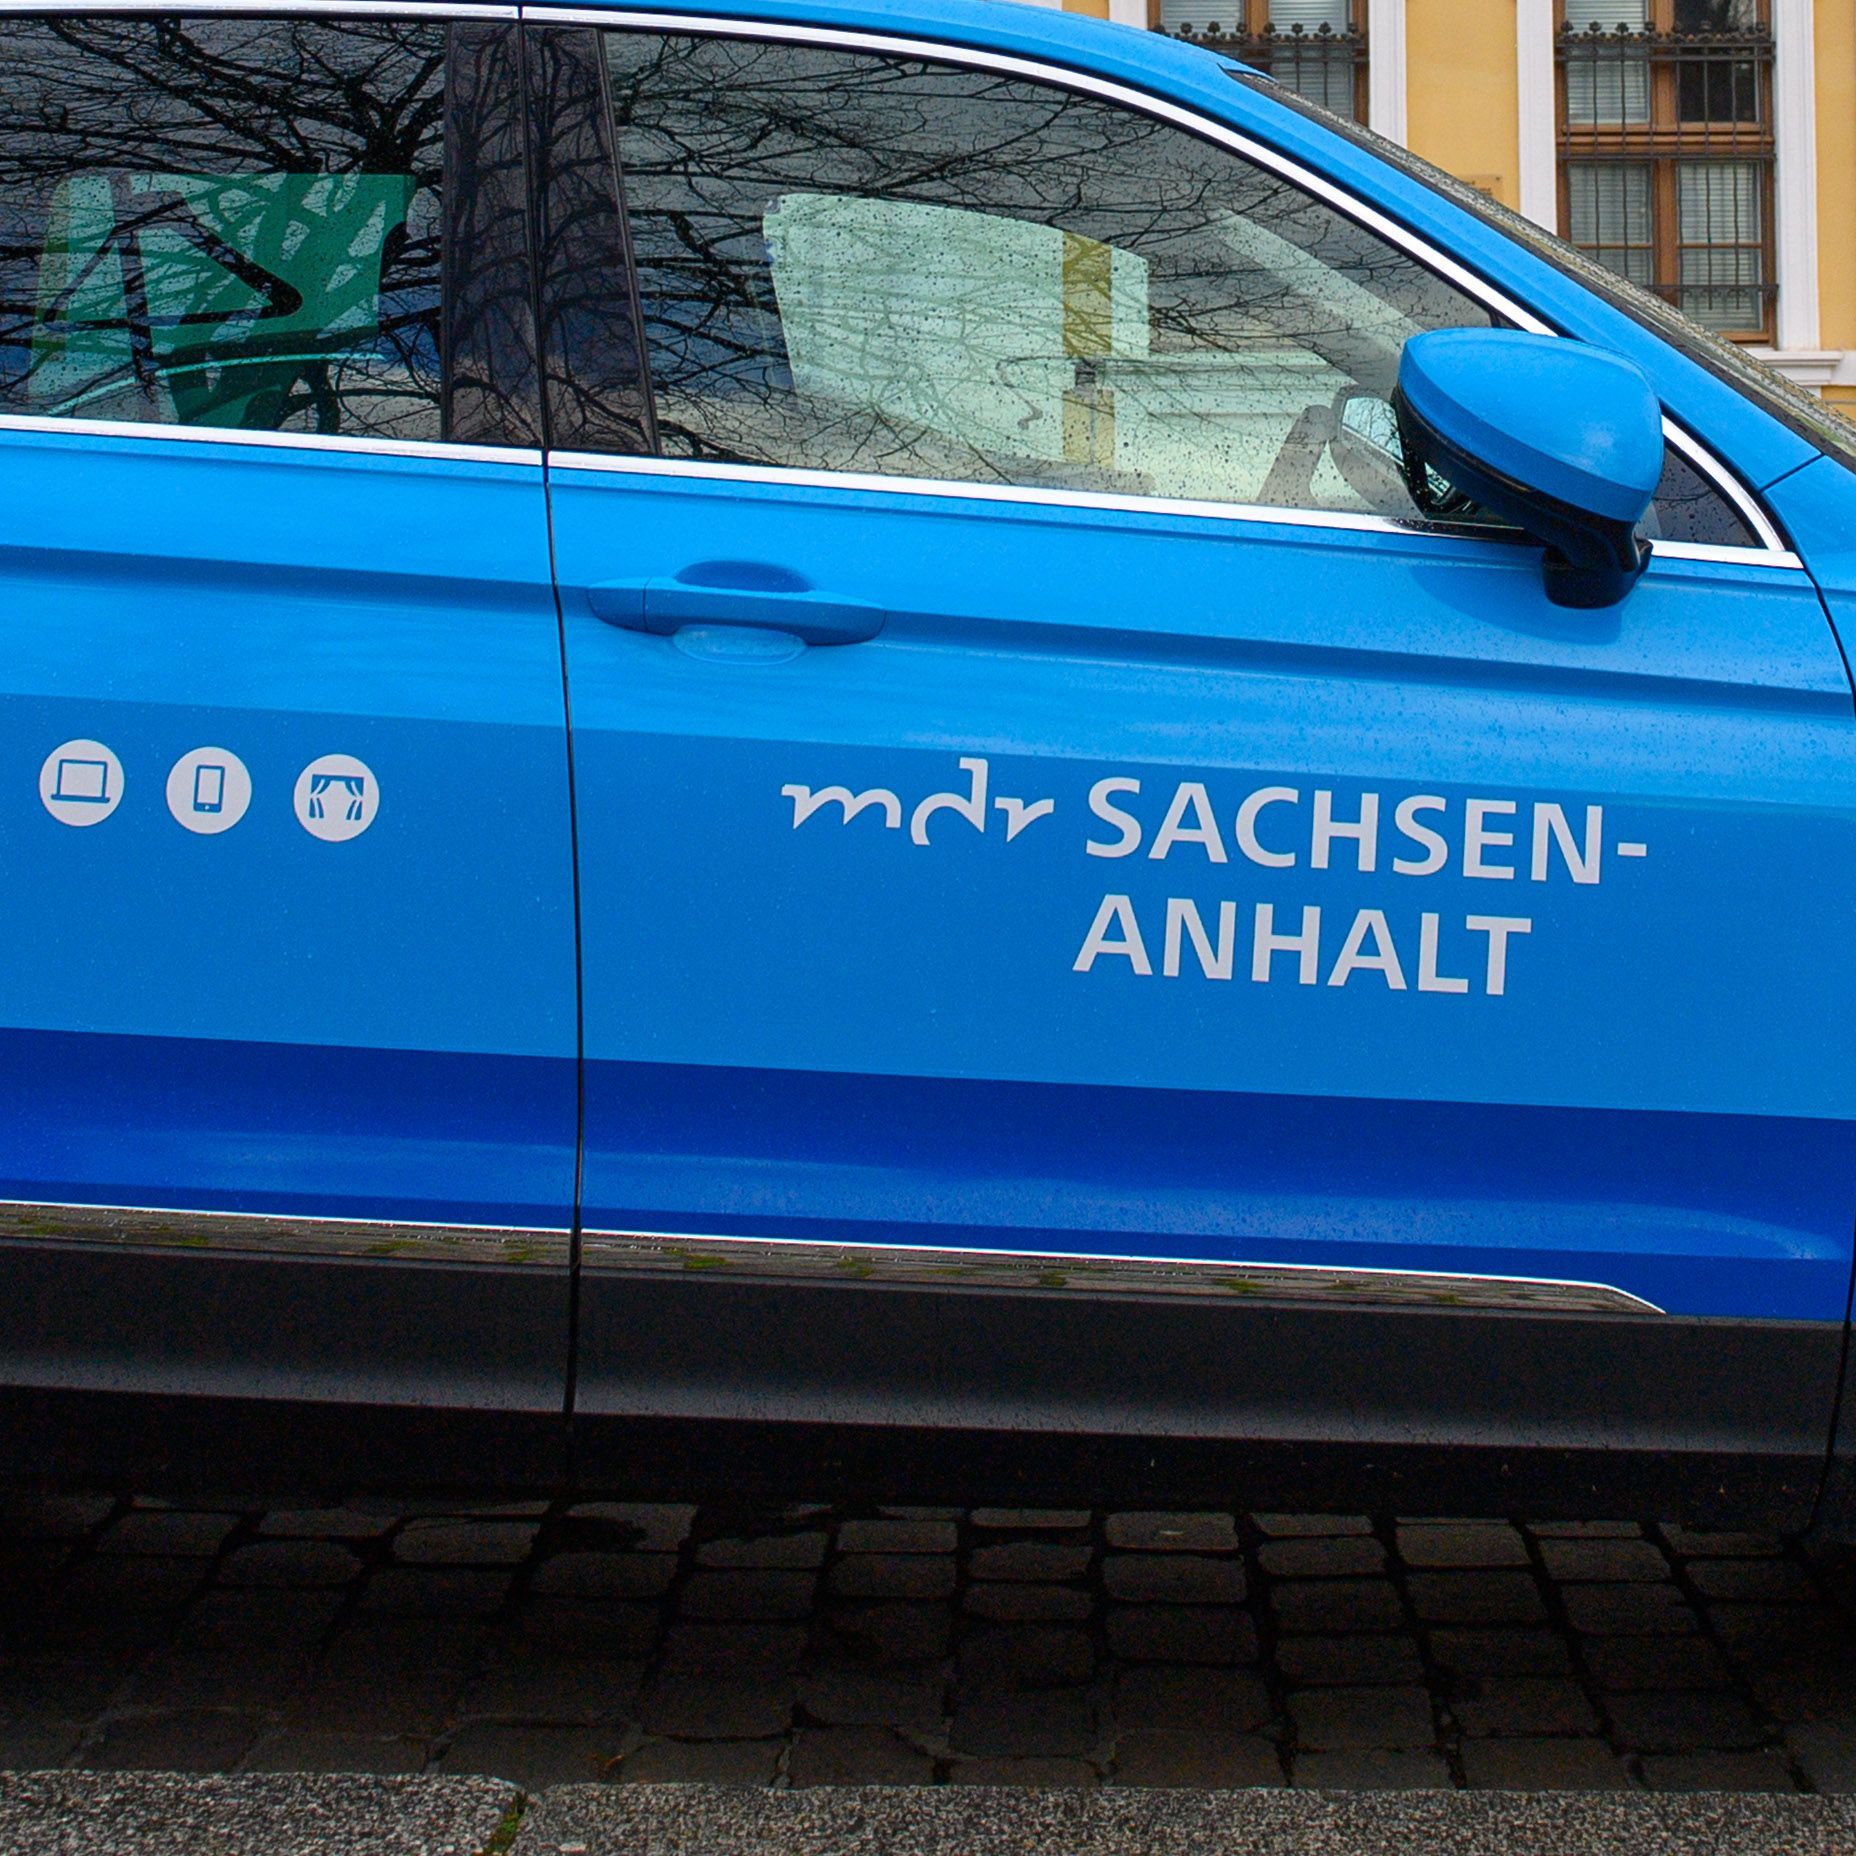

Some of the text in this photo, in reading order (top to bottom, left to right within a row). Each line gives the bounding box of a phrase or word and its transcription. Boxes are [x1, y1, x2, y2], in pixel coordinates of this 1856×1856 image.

[781, 757, 1647, 885] mdr SACHSEN-
[1072, 894, 1532, 996] ANHALT
